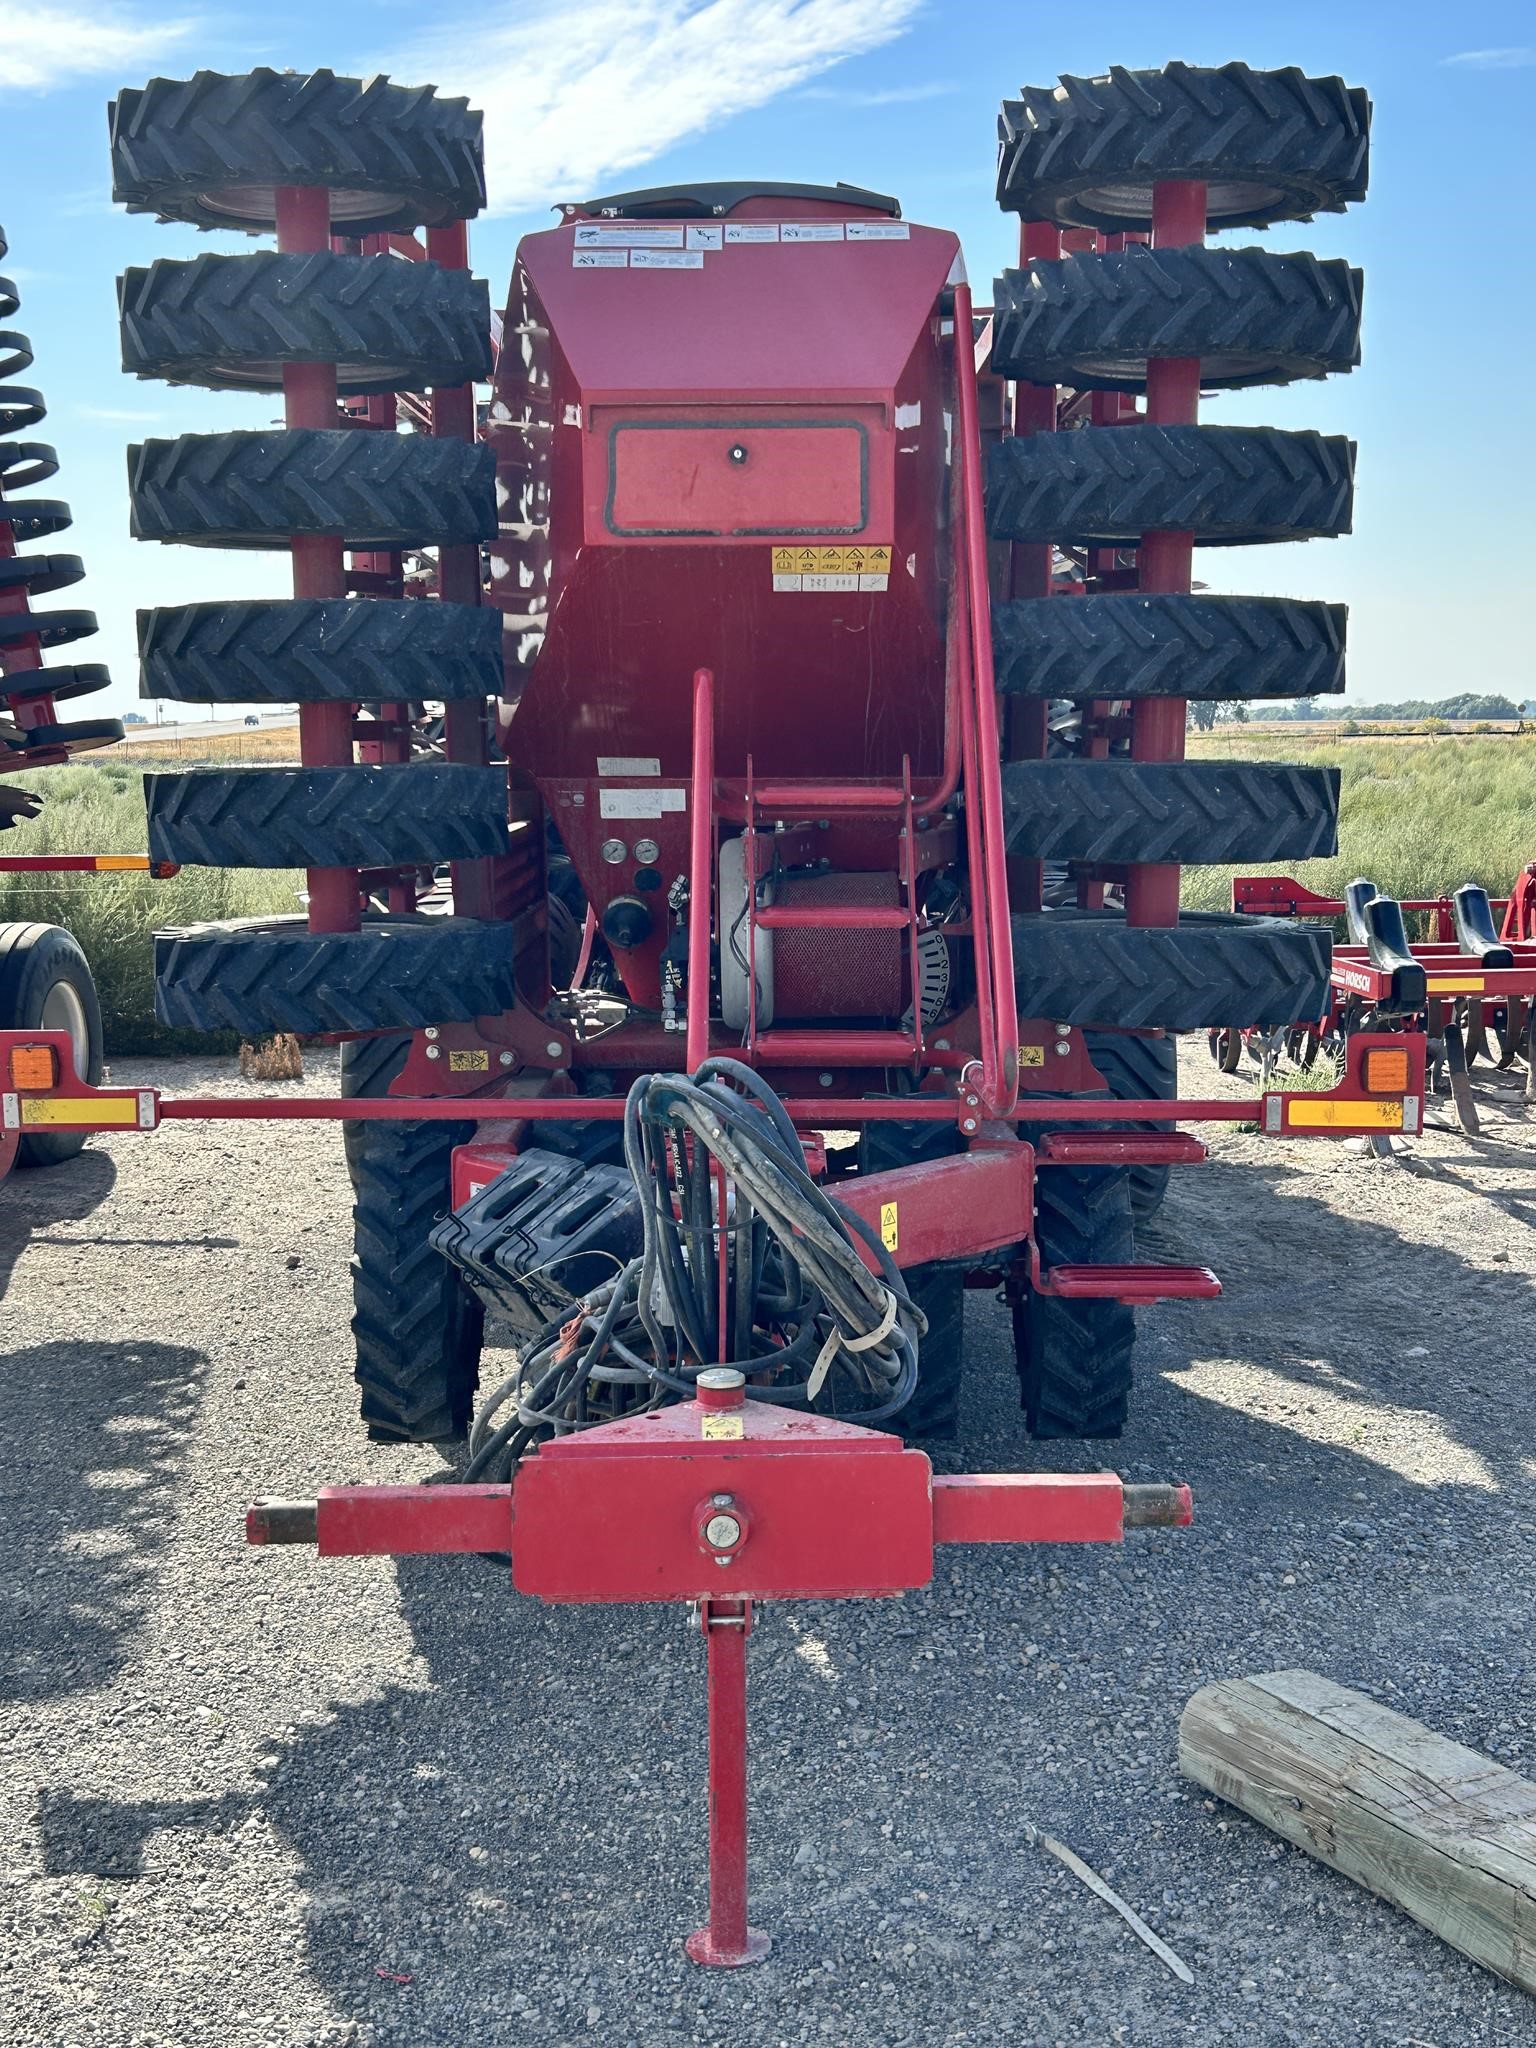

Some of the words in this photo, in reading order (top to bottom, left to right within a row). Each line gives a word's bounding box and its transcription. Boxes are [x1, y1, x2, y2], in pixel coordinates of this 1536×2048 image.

[935, 935, 943, 944] 0
[939, 946, 946, 955] 1
[941, 960, 949, 969] 2
[941, 973, 948, 983] 3
[939, 985, 946, 995] 4
[929, 1009, 938, 1019] 6
